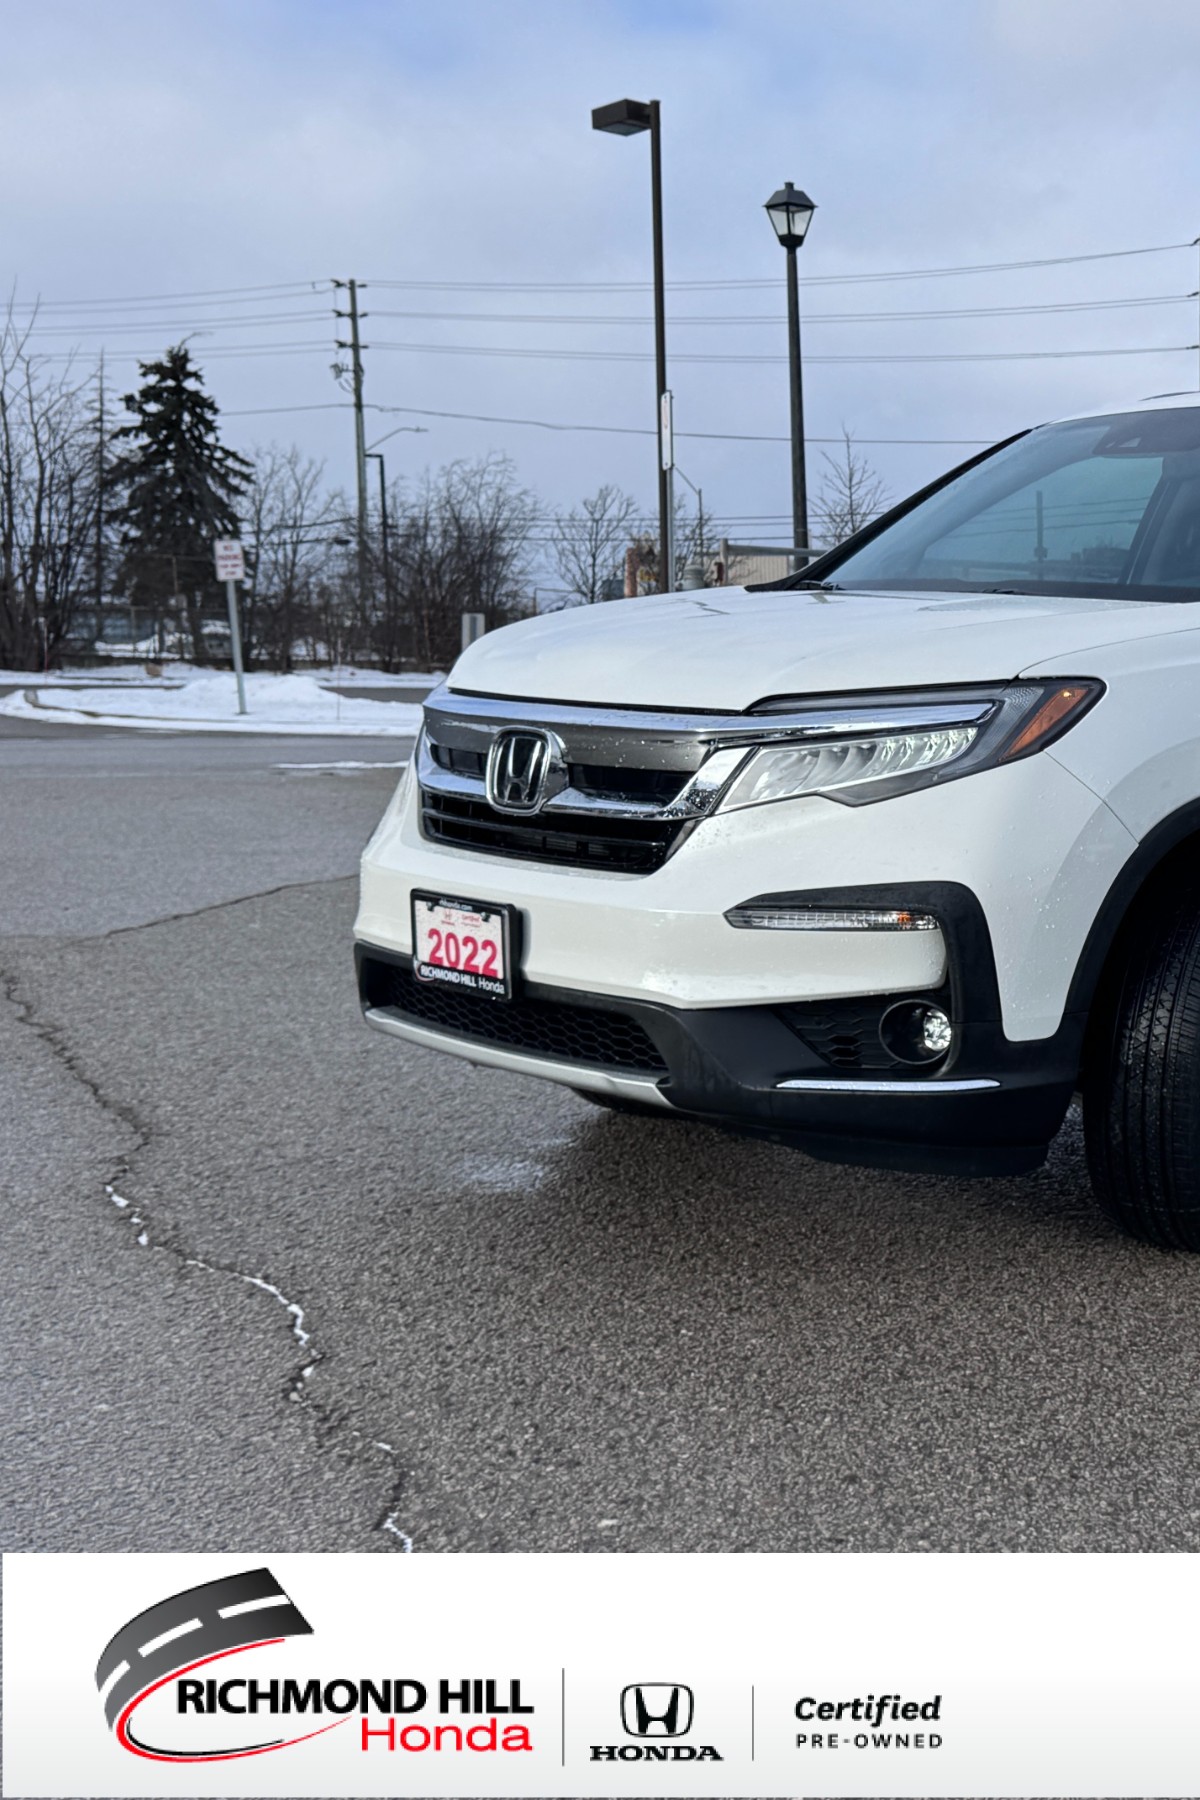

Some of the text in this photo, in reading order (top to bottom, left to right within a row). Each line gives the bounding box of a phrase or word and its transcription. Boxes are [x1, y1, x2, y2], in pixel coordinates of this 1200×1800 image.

[428, 928, 498, 977] 2022
[420, 965, 505, 994] RICHMOND HILL Honda
